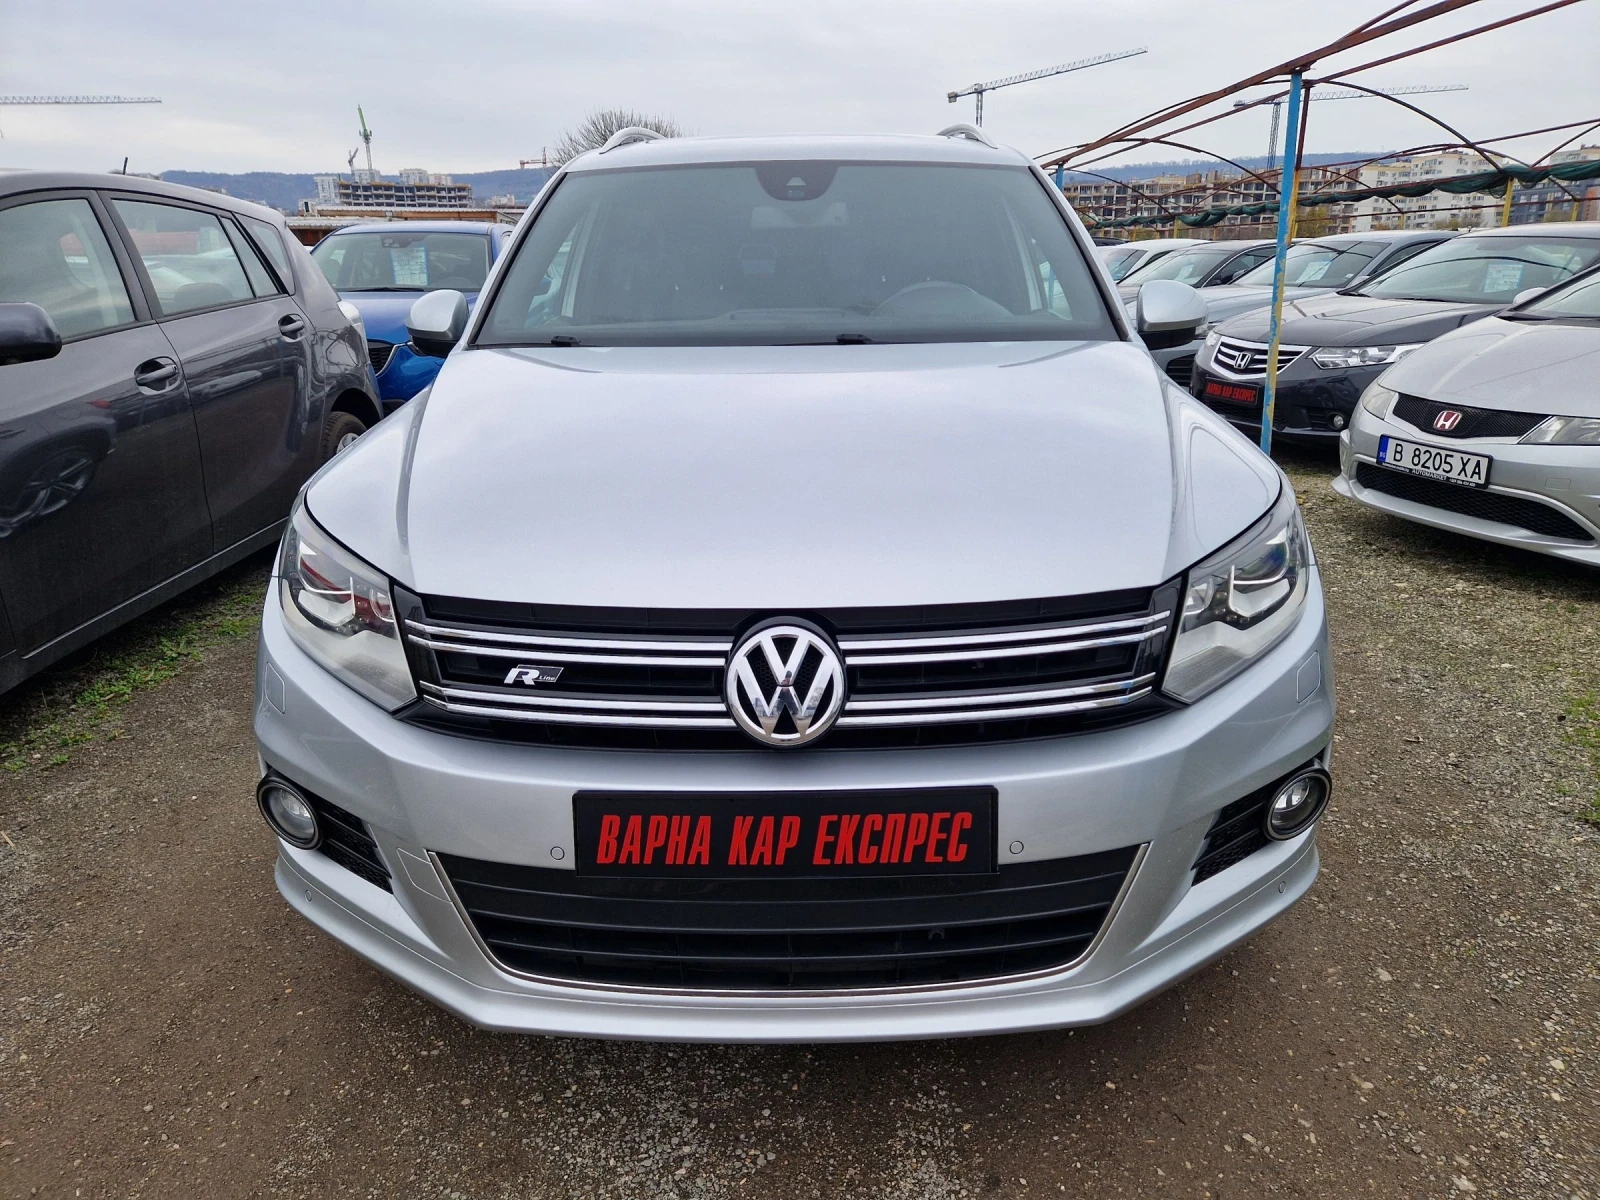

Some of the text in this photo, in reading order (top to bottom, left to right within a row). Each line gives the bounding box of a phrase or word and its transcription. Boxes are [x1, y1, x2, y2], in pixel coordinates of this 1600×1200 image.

[1393, 443, 1404, 462] B
[1411, 447, 1454, 474] 8205
[1457, 456, 1482, 480] XA
[1411, 468, 1447, 480] AUTOMARKET
[503, 667, 540, 685] R
[596, 812, 973, 866] ВАРНА КАР ЕКСПРЕС
